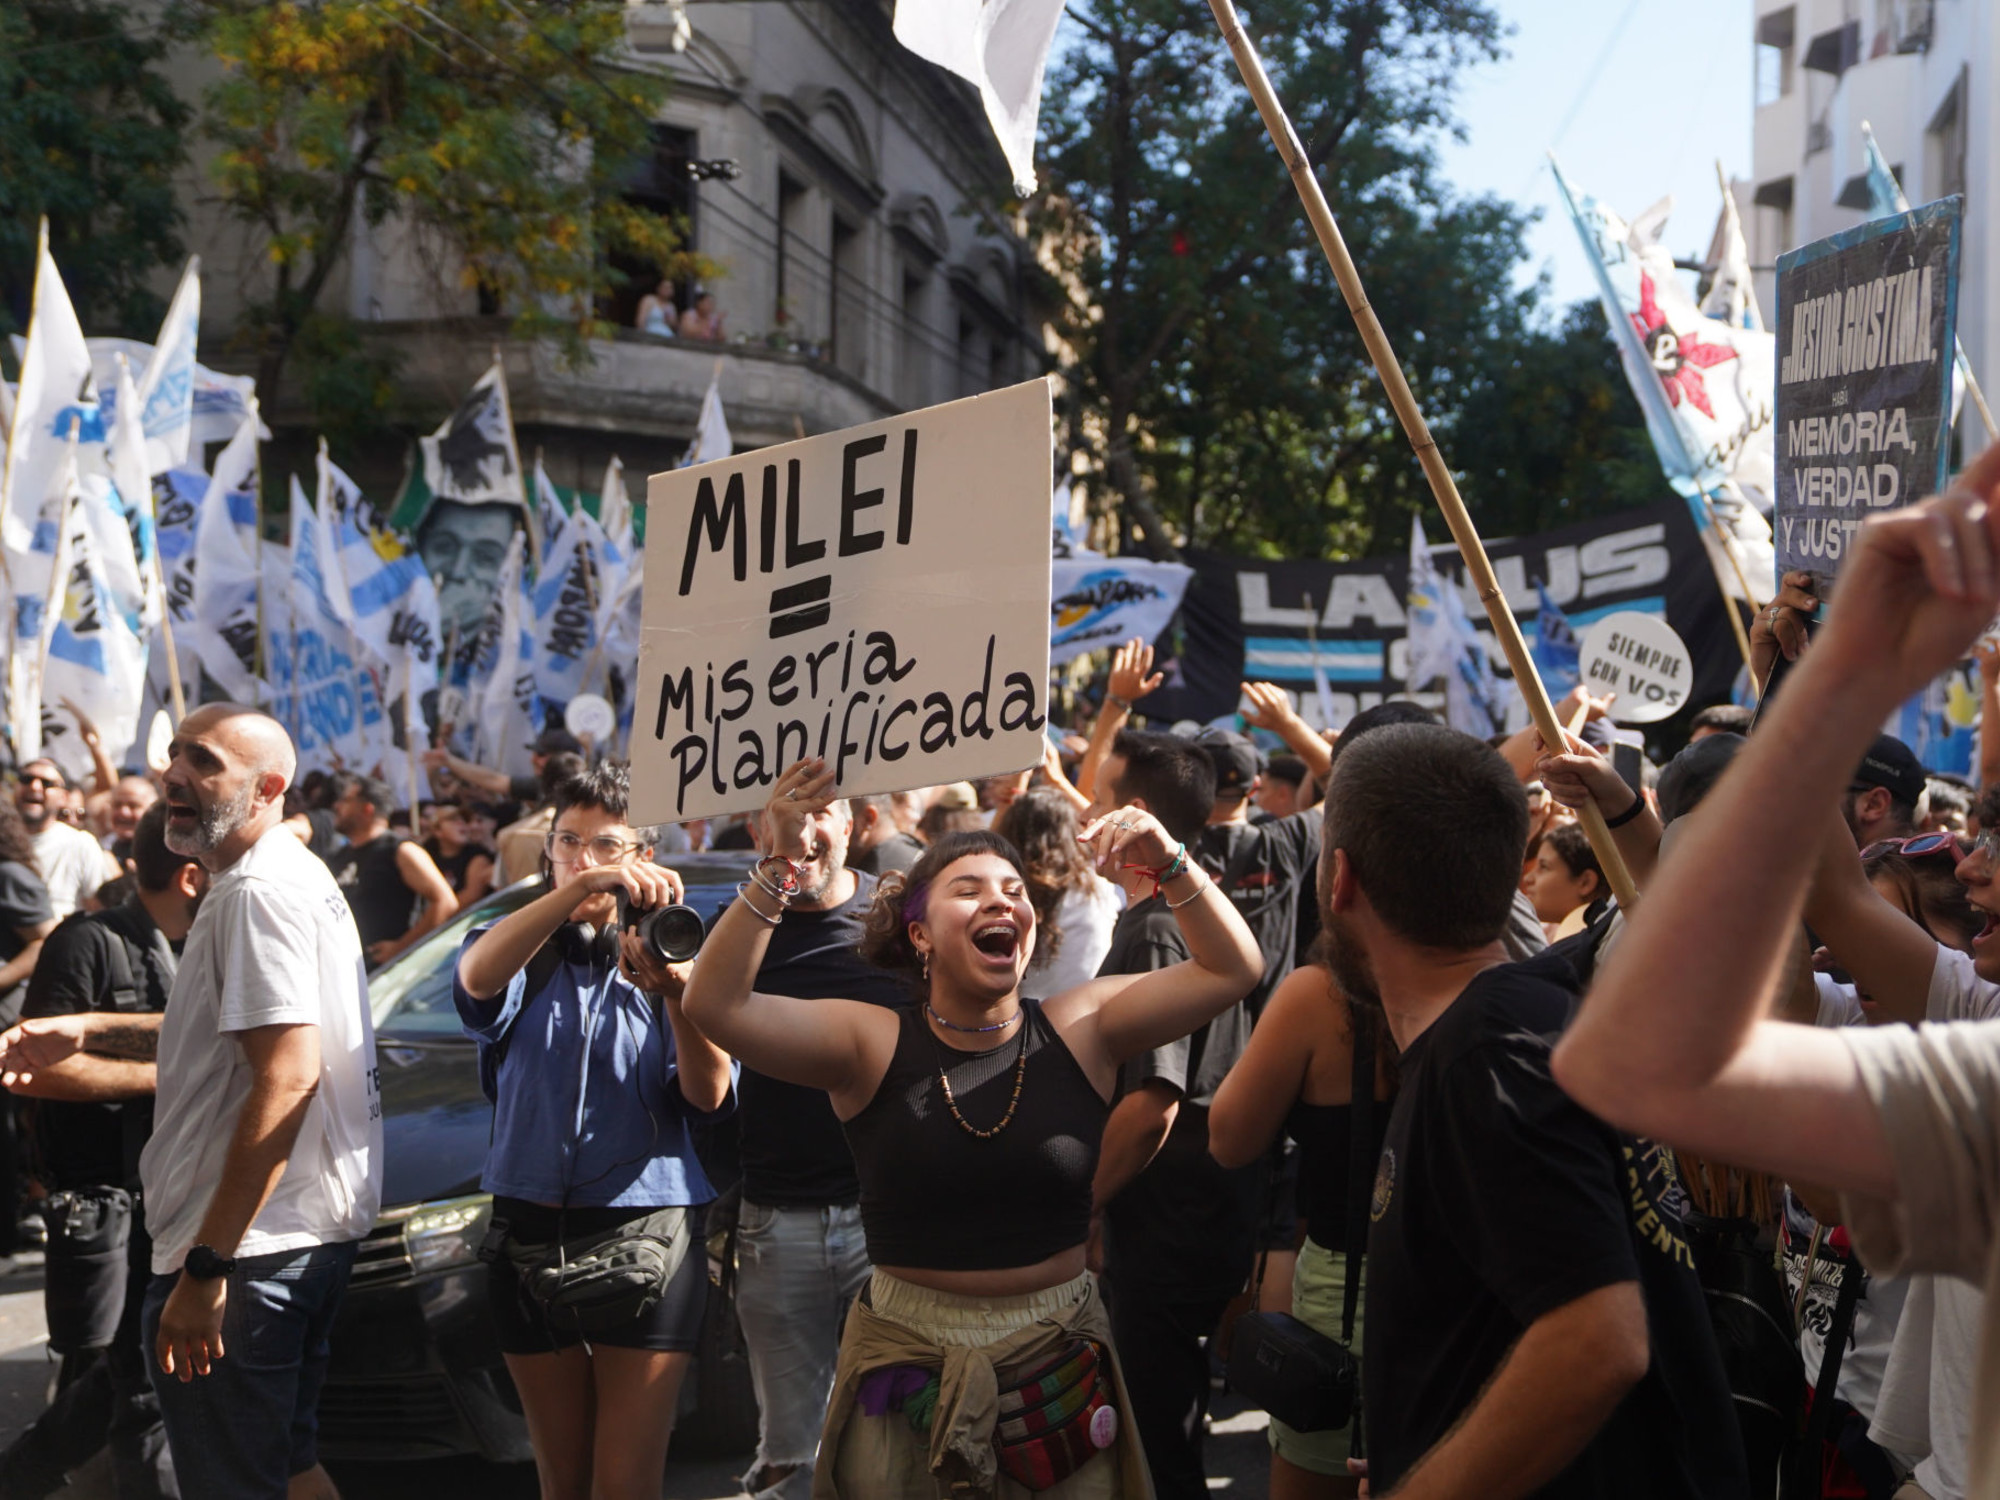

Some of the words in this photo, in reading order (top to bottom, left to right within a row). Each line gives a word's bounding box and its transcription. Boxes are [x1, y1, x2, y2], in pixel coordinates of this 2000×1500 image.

[1788, 408, 1917, 457] MEMORIA,
[1795, 464, 1900, 507] VERDAD
[679, 429, 918, 596] MILEI
[1782, 517, 1795, 554] Y
[1800, 518, 1864, 560] JUST
[1608, 632, 1682, 679] SIEMPRE
[655, 629, 917, 740] Miseria
[1589, 658, 1621, 685] CON
[1629, 674, 1681, 707] VOS
[670, 634, 1046, 816] planificada
